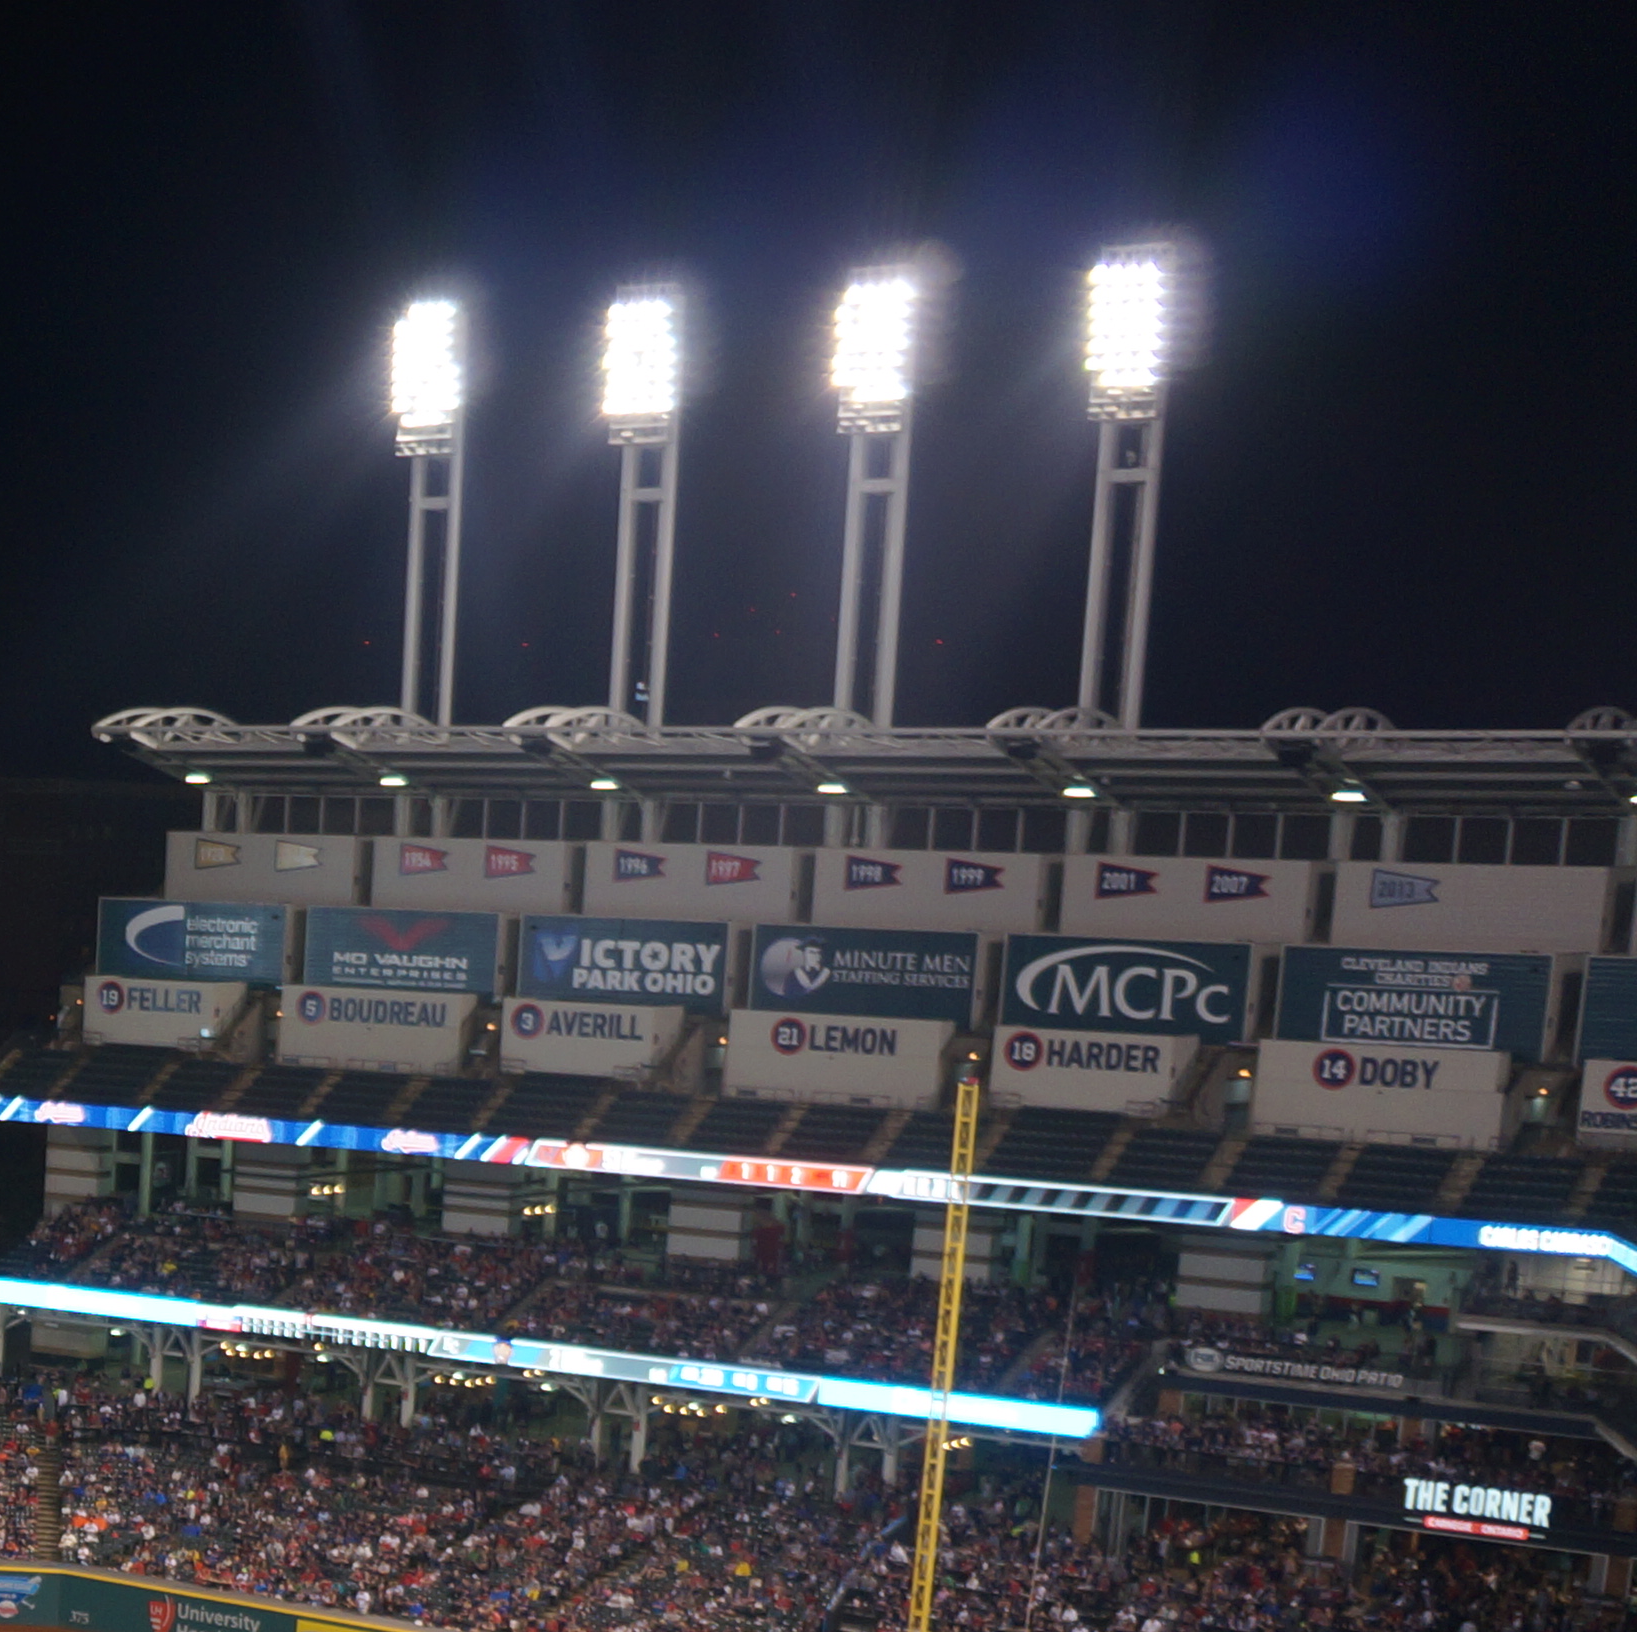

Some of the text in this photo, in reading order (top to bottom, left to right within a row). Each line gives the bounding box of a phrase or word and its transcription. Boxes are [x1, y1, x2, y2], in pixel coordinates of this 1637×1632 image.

[404, 849, 433, 868] 1954
[489, 852, 520, 872] 1995
[618, 856, 649, 876] 1996
[709, 859, 742, 880] 1997
[850, 862, 884, 884] 1998
[950, 865, 985, 887] 1999
[1100, 869, 1139, 893] 2001
[1210, 873, 1249, 897] 2007
[1377, 878, 1417, 900] 2013
[186, 916, 259, 935] electronic
[185, 934, 257, 951] merchant
[184, 951, 248, 969] systems
[332, 951, 469, 970] MO VAUGHN
[533, 930, 722, 984] VICTORY
[832, 949, 972, 974] MINUTE MEN
[1341, 957, 1490, 975] CLEVELAND INDIANS
[332, 967, 468, 981] ENTERPRISES
[572, 967, 715, 997] PARK OHIO
[832, 969, 972, 990] STAFFING SERVICES
[1375, 972, 1452, 988] CHARITIES
[100, 988, 202, 1014] 19 FELLER
[1336, 990, 1486, 1017] COMMUNITY
[304, 998, 446, 1028] 5 BOUDREAU
[519, 1009, 643, 1042] 3 AVERILL
[1343, 1014, 1473, 1042] PARTNERS
[776, 1025, 897, 1055] 21 LEMON
[1010, 1038, 1160, 1074] 18 HARDER
[1320, 1057, 1440, 1089] 14 DOBY
[185, 1110, 272, 1142] Indians
[1225, 1354, 1404, 1389] SPORTSTIME OHIO PATIO
[1403, 1477, 1551, 1528] THE CORNER
[69, 1610, 90, 1625] 375
